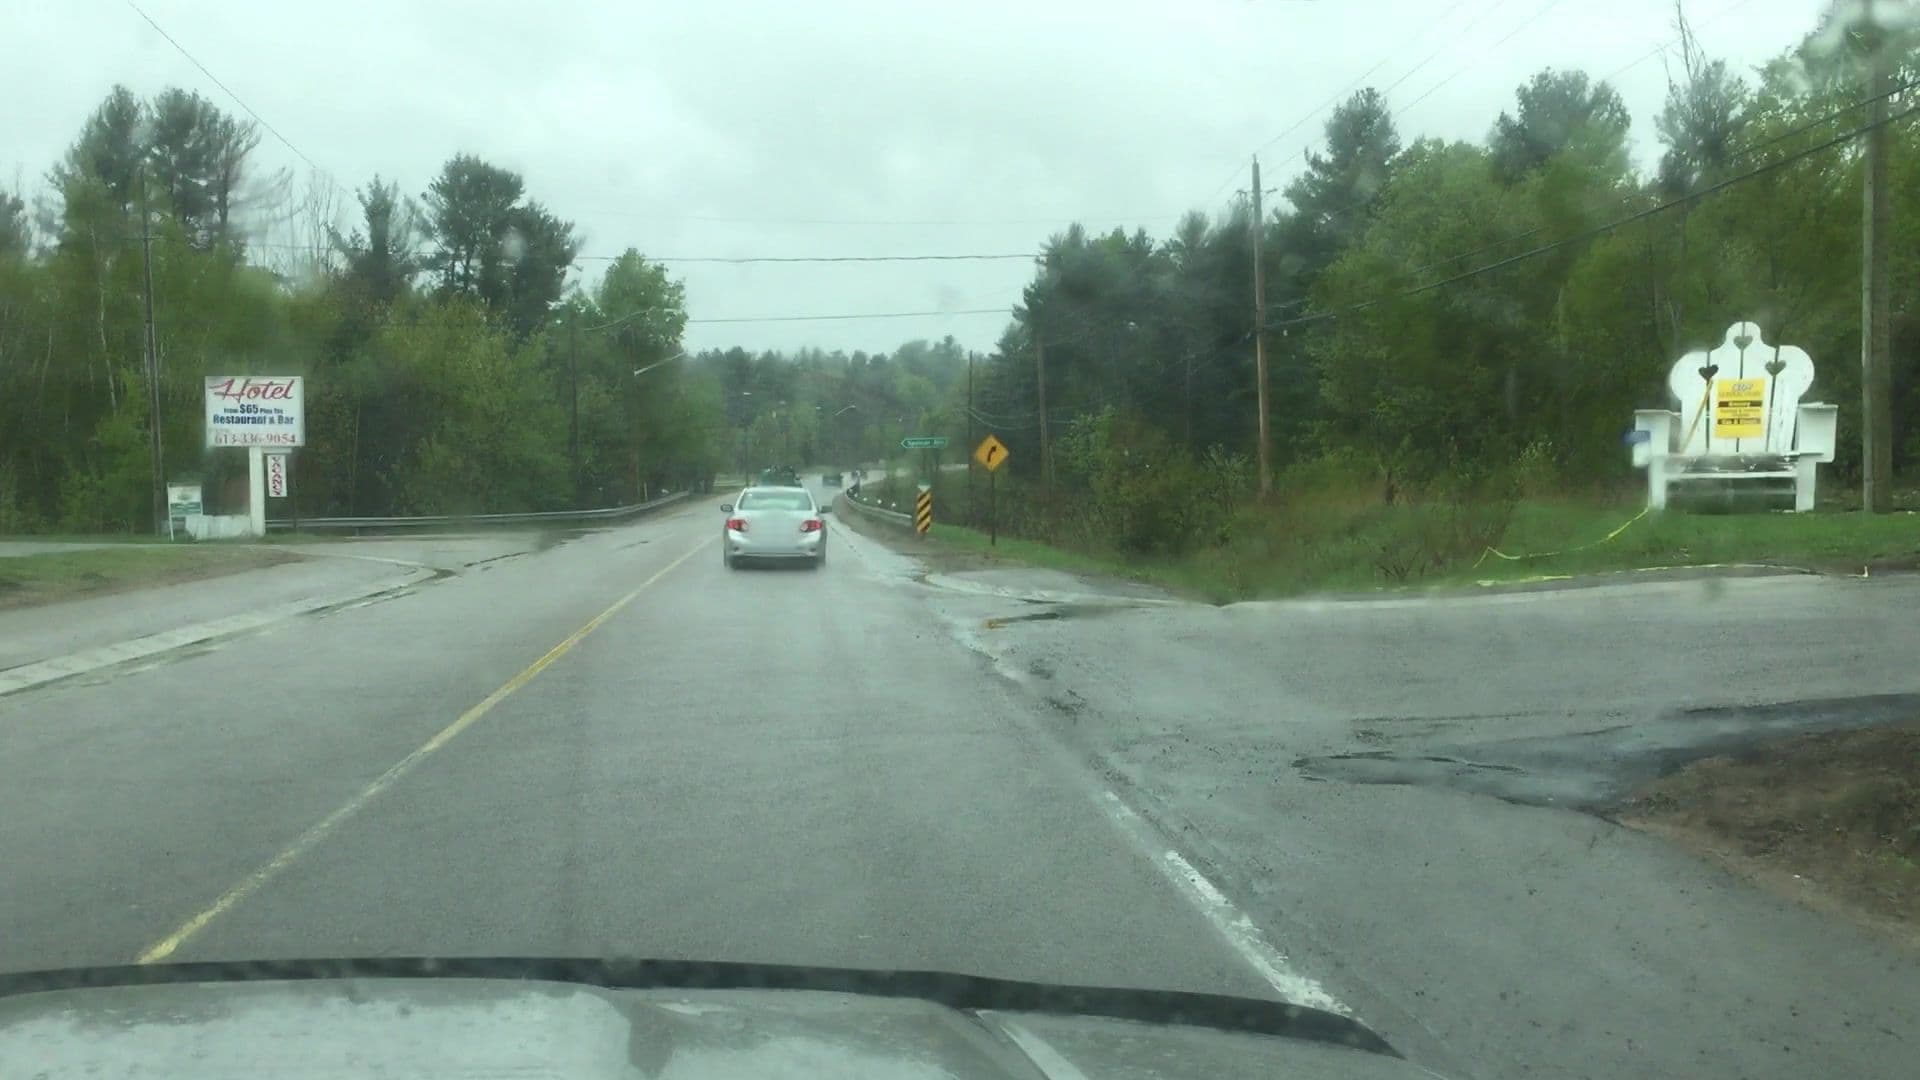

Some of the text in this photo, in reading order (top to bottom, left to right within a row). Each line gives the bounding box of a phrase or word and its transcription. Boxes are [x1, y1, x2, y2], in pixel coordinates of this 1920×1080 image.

[208, 378, 295, 403] Hotel
[239, 403, 259, 414] $65
[213, 415, 266, 425] Restaurant
[277, 415, 295, 425] Bar
[215, 433, 296, 444] 613-336-9054
